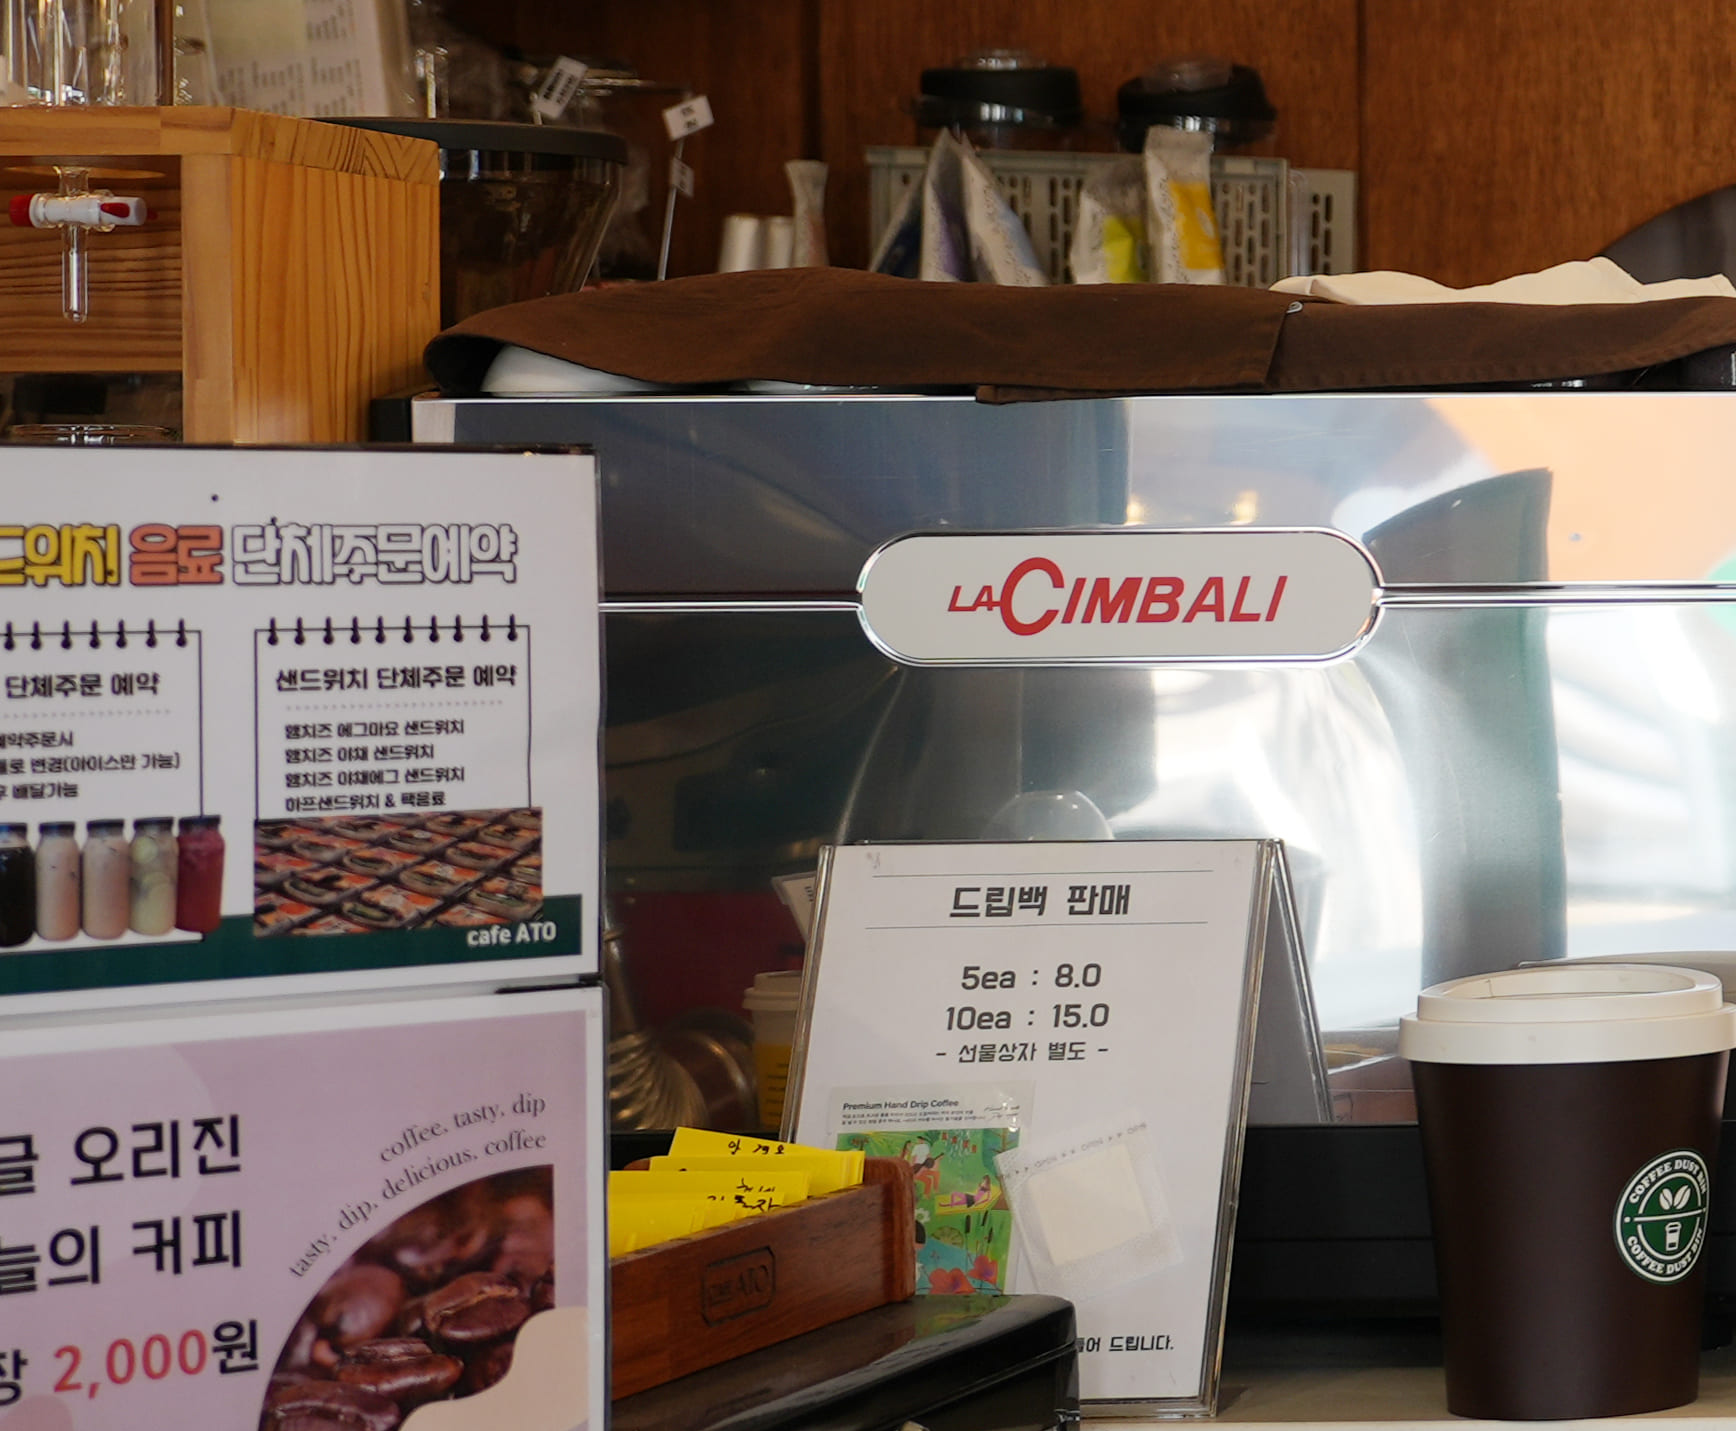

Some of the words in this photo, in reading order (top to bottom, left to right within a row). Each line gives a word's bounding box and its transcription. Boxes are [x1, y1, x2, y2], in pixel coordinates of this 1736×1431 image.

[129, 524, 224, 587] 음료
[232, 523, 518, 586] 단체주문예약
[948, 585, 1000, 612] LA
[1000, 557, 1288, 636] CIMBALI
[276, 668, 368, 691] 샌드위치
[377, 666, 464, 689] 단체주문
[473, 664, 516, 687] 예약
[949, 885, 1048, 917] 드립백
[1068, 884, 1131, 916] 판매
[467, 924, 511, 947] cafe
[516, 921, 557, 944] ATO
[961, 966, 1016, 991] 5ea
[1055, 964, 1102, 988] 8.0
[946, 1007, 1012, 1032] 10ea
[1051, 1004, 1110, 1029] 15.0
[843, 1102, 882, 1110] Premium
[885, 1100, 908, 1108] Hand
[910, 1100, 929, 1109] Drip
[931, 1099, 959, 1107] Coffee
[70, 1114, 242, 1187] 오리진
[484, 1129, 546, 1156] coffee
[1629, 1162, 1672, 1204] COFFEE
[1674, 1160, 1700, 1174] DUST
[132, 1210, 242, 1275] 커피
[52, 1318, 259, 1400] 2,000원
